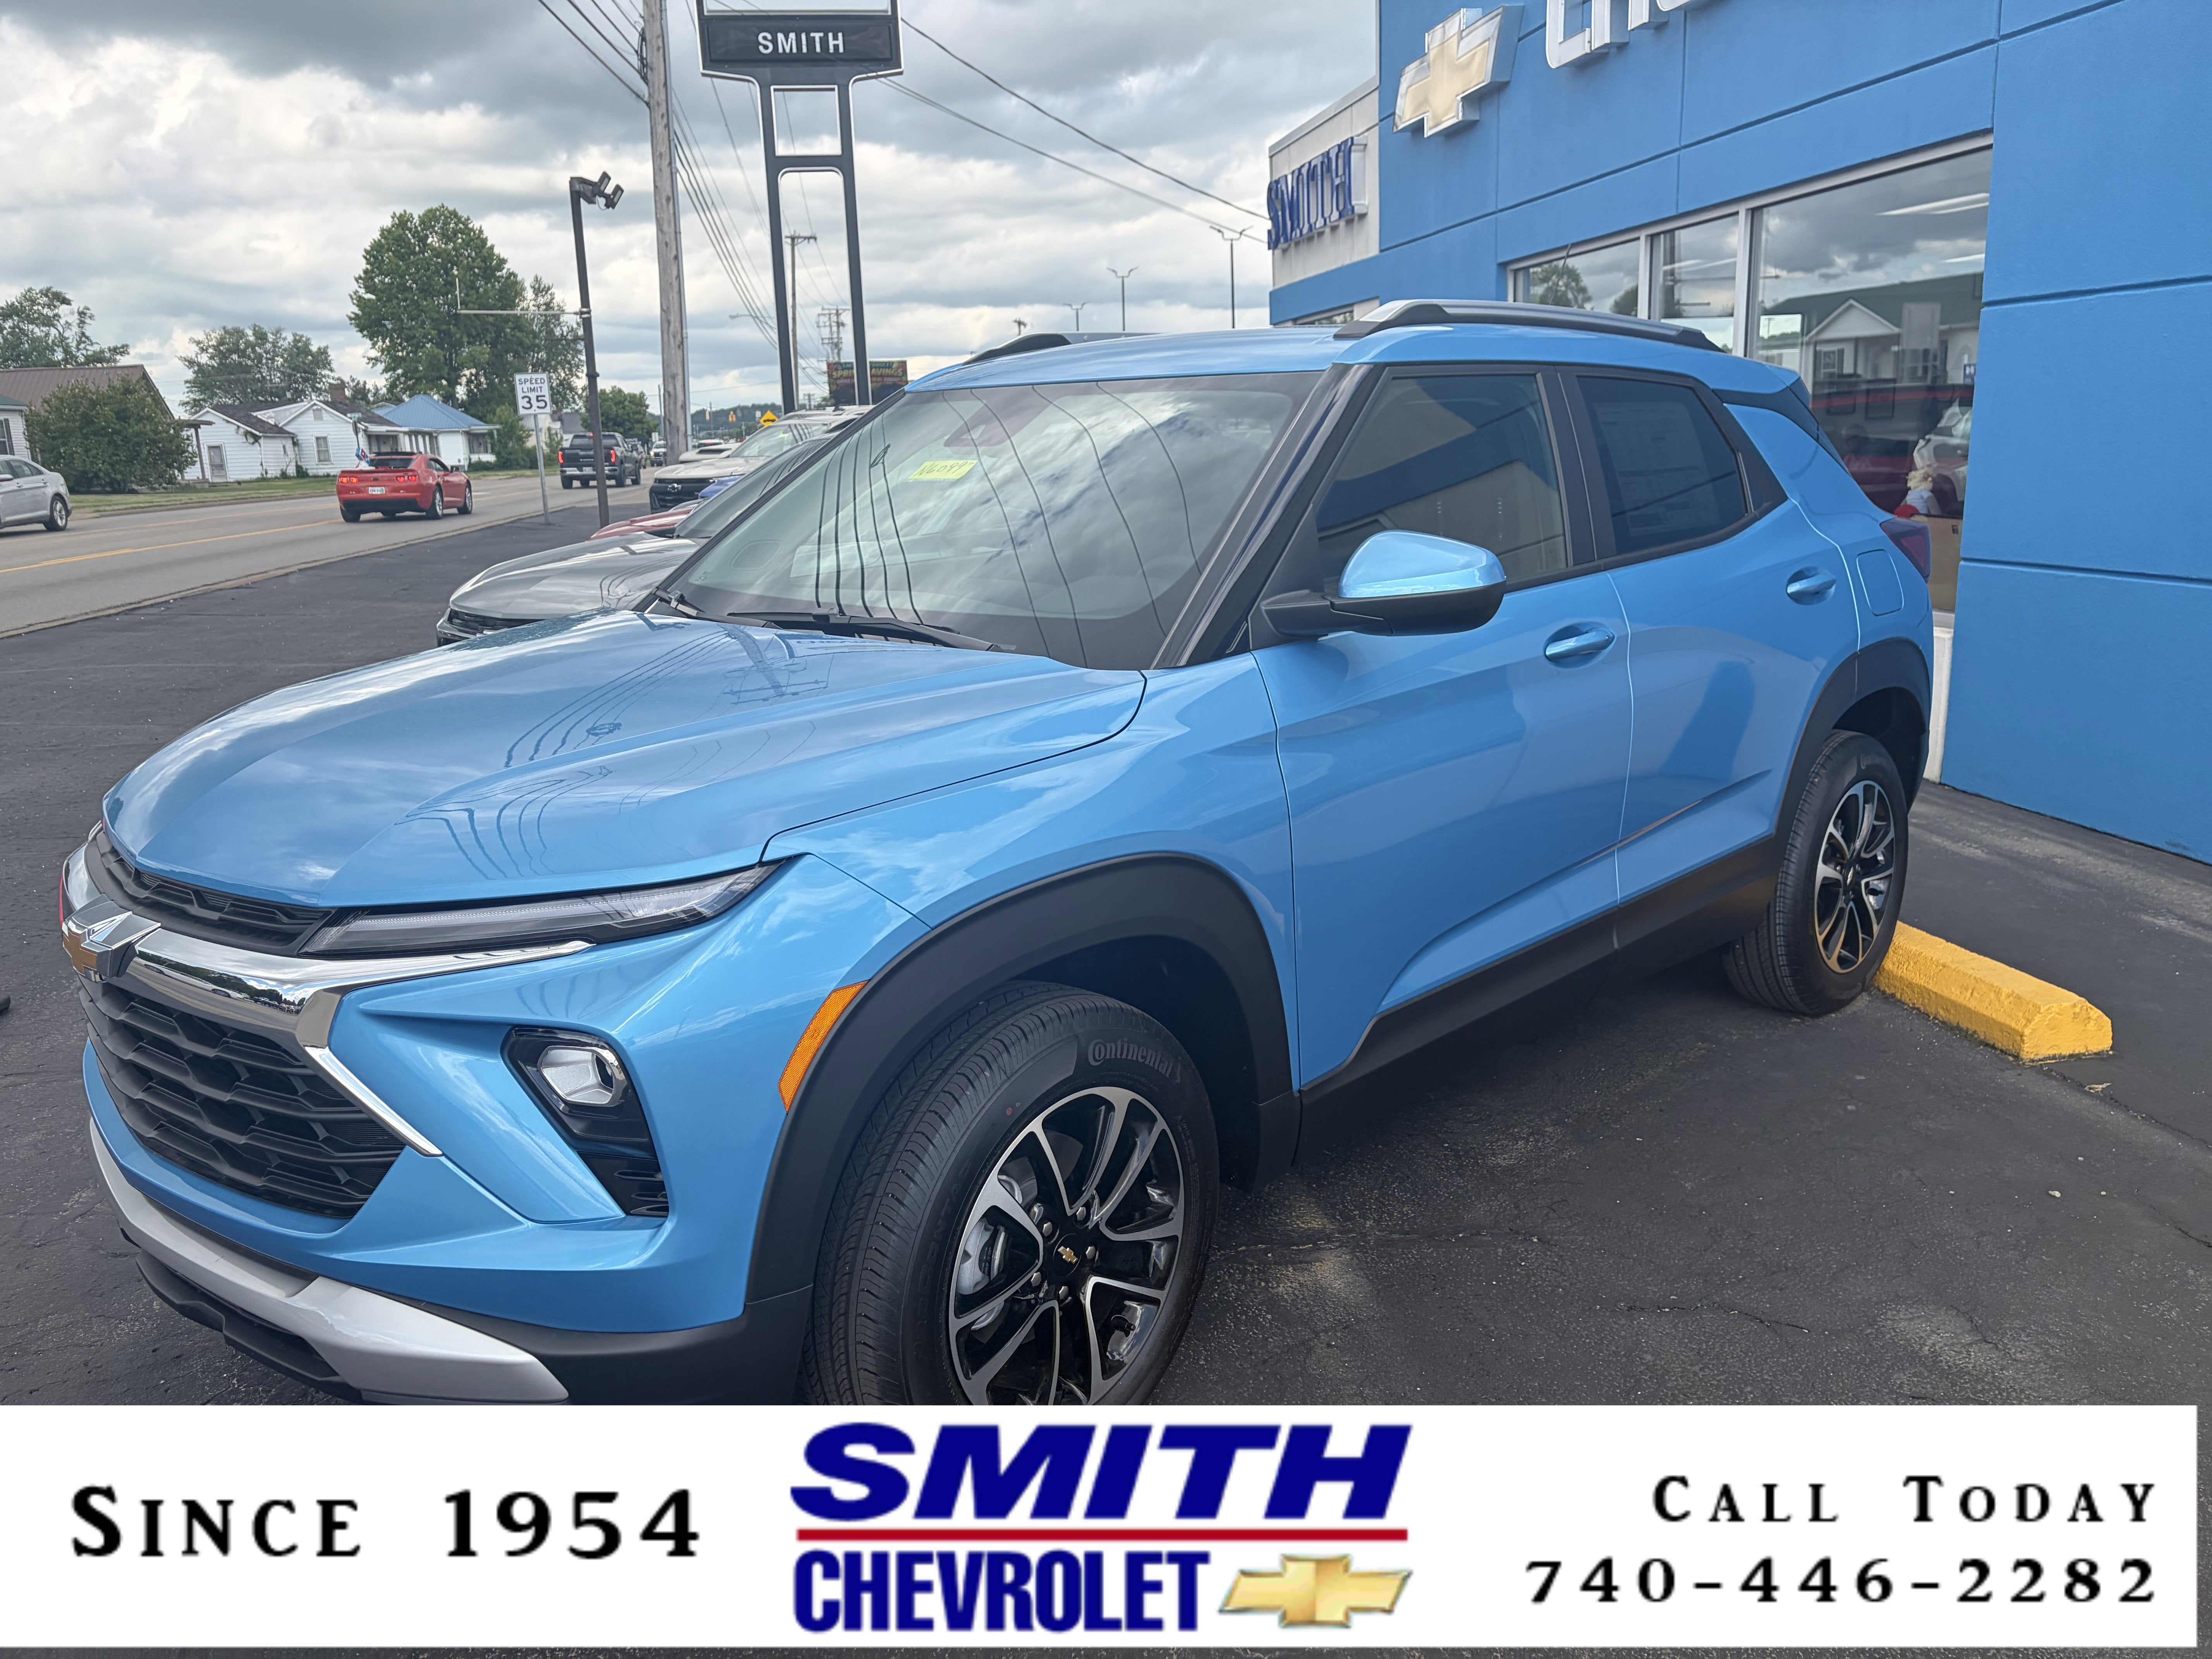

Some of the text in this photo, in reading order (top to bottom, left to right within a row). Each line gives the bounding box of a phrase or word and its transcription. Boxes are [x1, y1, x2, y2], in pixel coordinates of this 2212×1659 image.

[757, 32, 844, 54] SMITH
[1267, 136, 1355, 250] SMITH
[521, 395, 548, 409] 35
[1088, 1037, 1173, 1079] Continental
